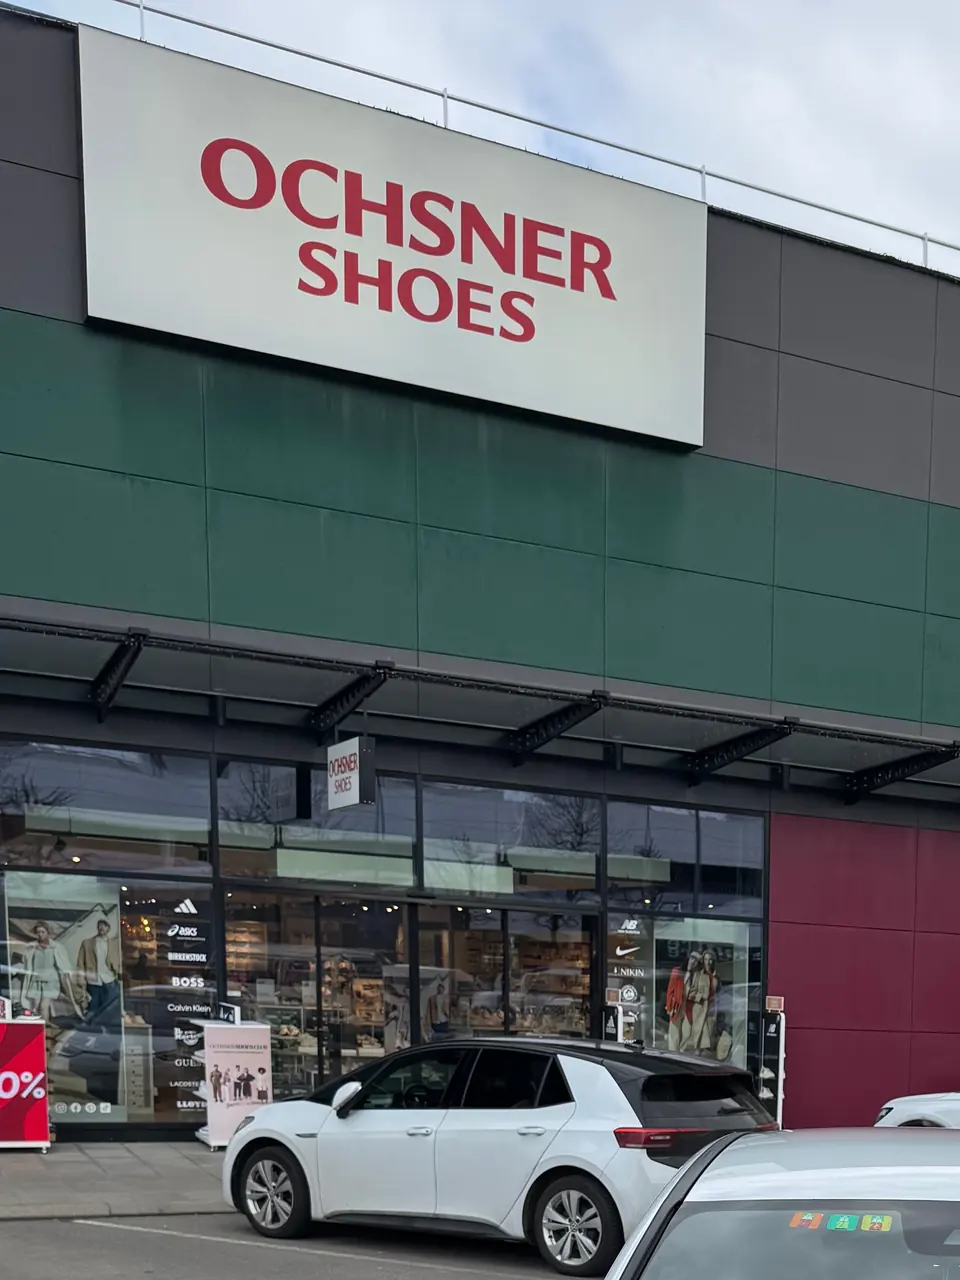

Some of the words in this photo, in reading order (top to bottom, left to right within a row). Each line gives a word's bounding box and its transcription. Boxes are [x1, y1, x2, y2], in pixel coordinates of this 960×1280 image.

[200, 137, 617, 302] OCHSNER
[297, 240, 536, 343] SHOES
[329, 753, 358, 777] OCHSNER
[335, 776, 352, 794] SHOES
[167, 951, 207, 963] BIRKENSTOCK
[620, 966, 645, 977] NIKIN
[172, 977, 204, 987] BOSS
[167, 1003, 193, 1013] Calvin
[193, 1004, 212, 1013] Klein
